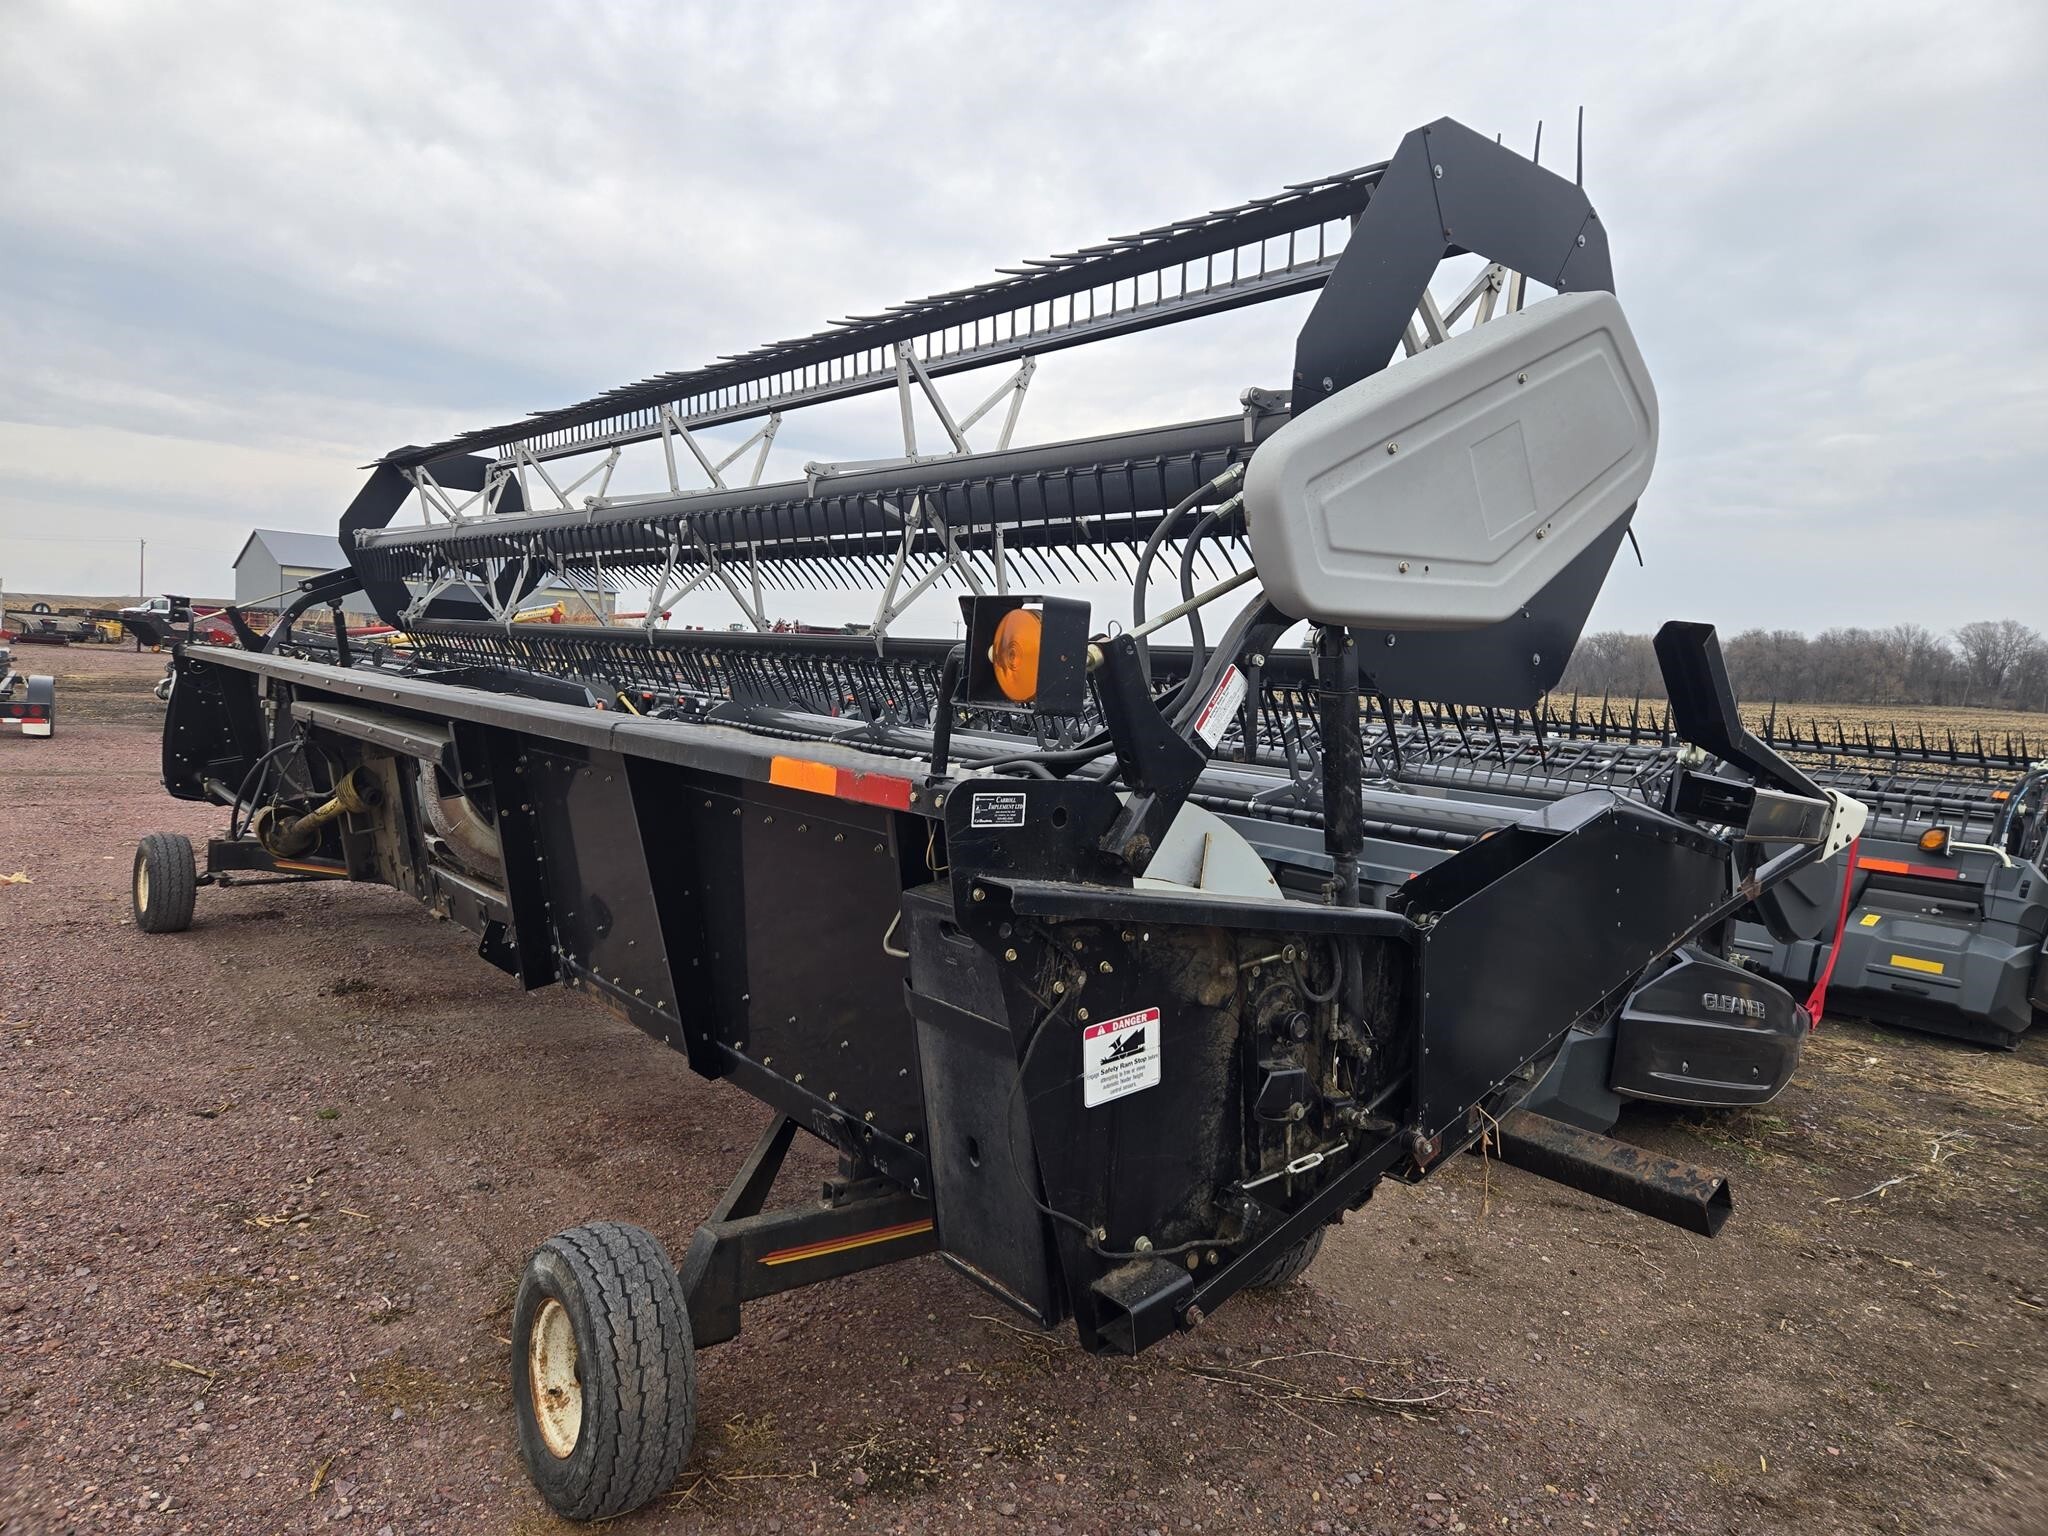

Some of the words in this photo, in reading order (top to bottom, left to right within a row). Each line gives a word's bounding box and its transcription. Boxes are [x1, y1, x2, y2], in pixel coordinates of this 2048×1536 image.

[988, 802, 1014, 810] IMPLEMENT
[1702, 992, 1766, 1019] GLEANER
[1112, 1013, 1148, 1031] DANGER
[1100, 1064, 1119, 1076] Safety
[1119, 1061, 1134, 1070] Ram
[1133, 1056, 1148, 1065] Stop
